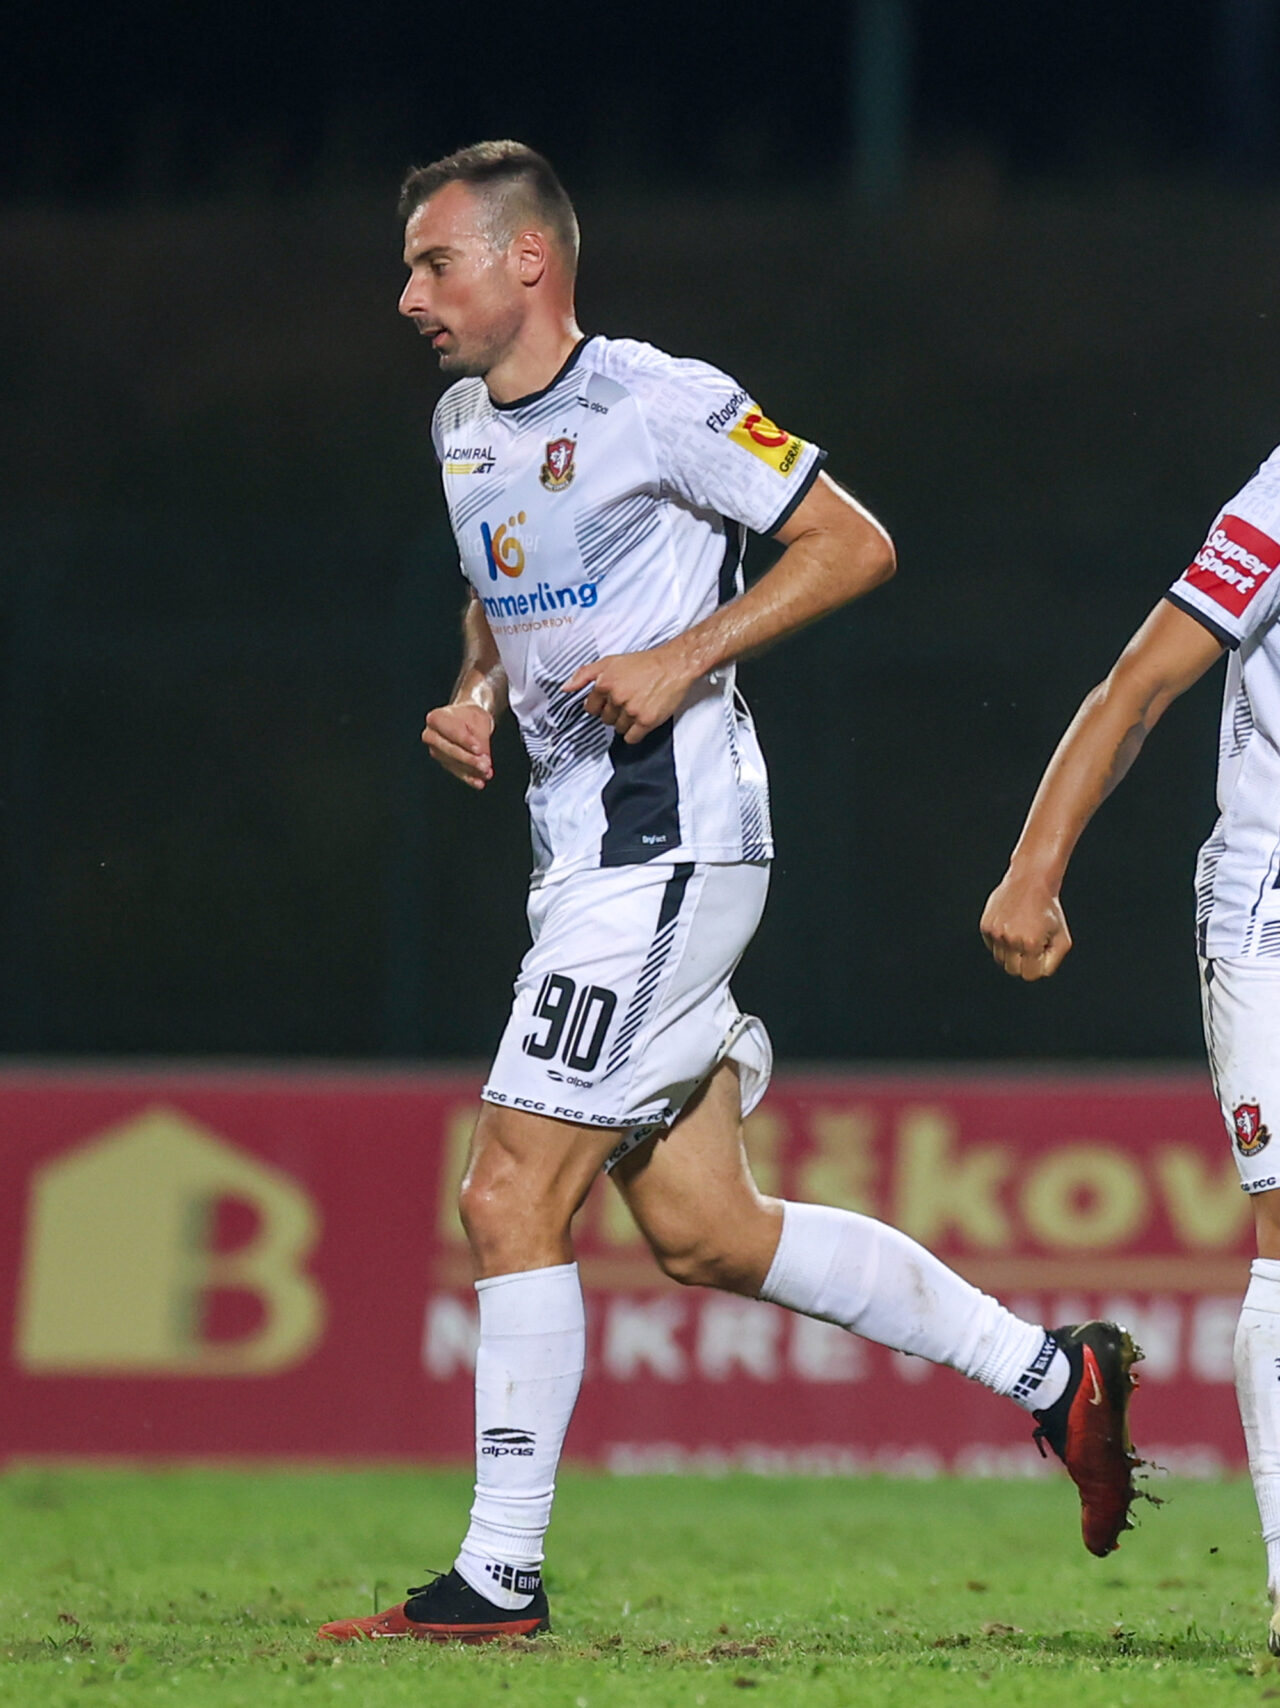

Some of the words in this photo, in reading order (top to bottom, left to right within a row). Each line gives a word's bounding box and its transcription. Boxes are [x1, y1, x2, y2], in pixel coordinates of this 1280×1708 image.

[590, 402, 608, 414] alpa
[445, 446, 496, 461] ADMIRAL
[779, 440, 802, 472] GERM
[1208, 530, 1272, 576] Super
[1195, 549, 1256, 594] Sport
[483, 580, 600, 618] mmerling
[522, 973, 618, 1073] 90
[487, 1090, 507, 1102] FCG
[514, 1098, 546, 1111] FCG
[554, 1106, 585, 1119] FCG
[1253, 1177, 1276, 1189] FCG
[482, 1446, 535, 1458] alpas
